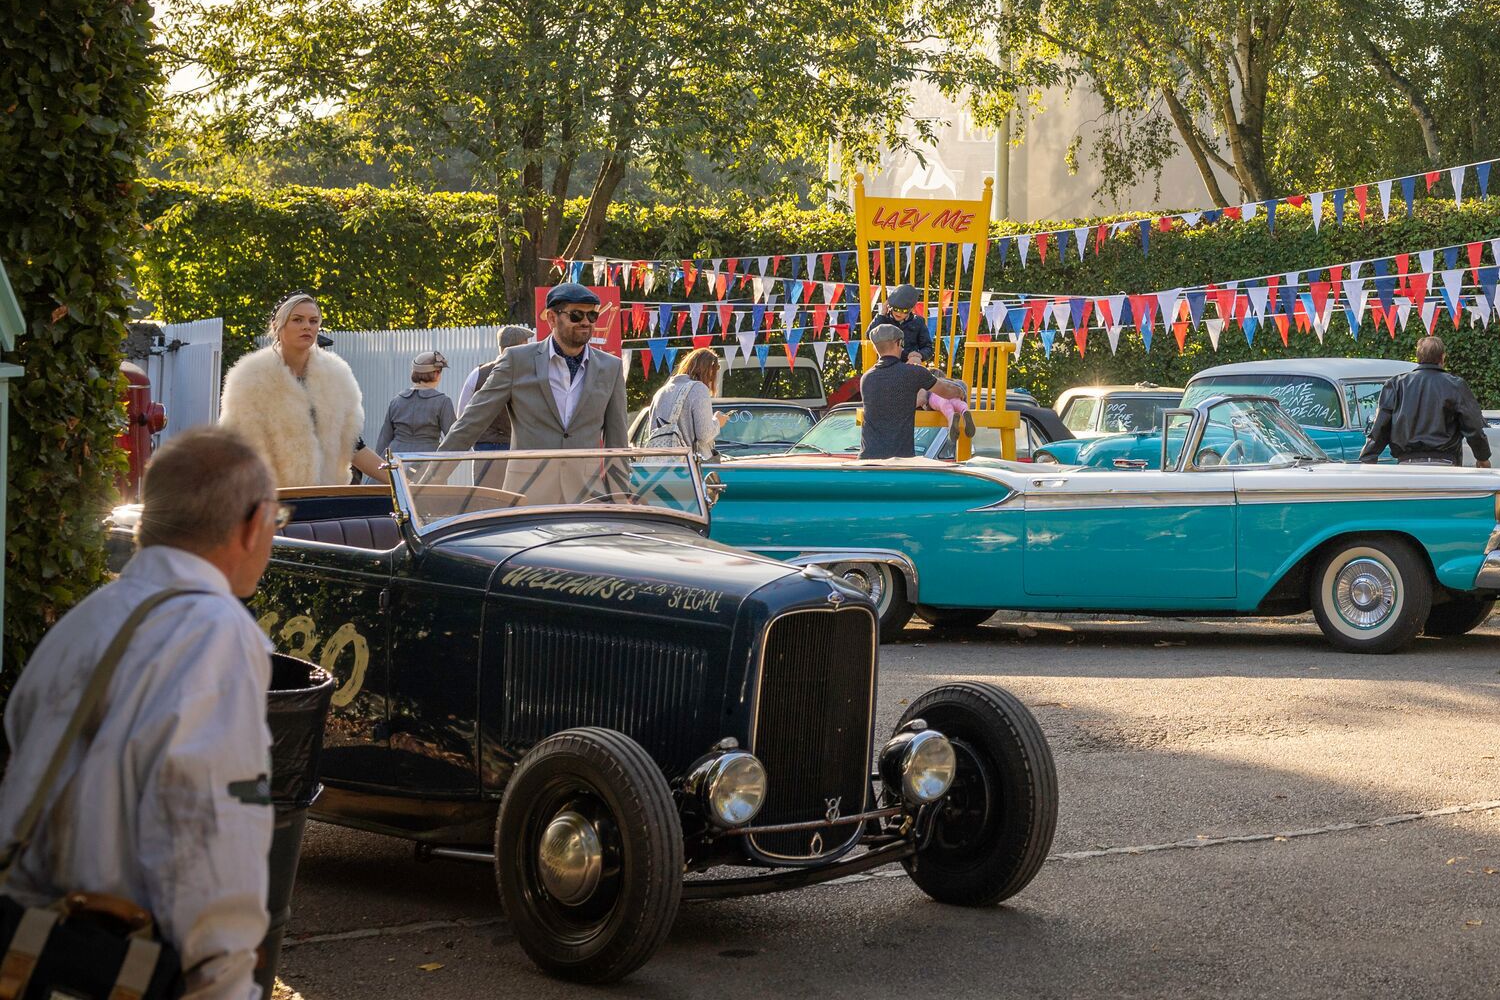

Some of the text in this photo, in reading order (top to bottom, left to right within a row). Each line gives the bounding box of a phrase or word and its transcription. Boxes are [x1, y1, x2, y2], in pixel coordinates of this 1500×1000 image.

[872, 206, 976, 233] LAZY ME
[1269, 383, 1312, 397] STATE
[1279, 393, 1315, 407] LINE
[668, 585, 724, 613] SPECIAL
